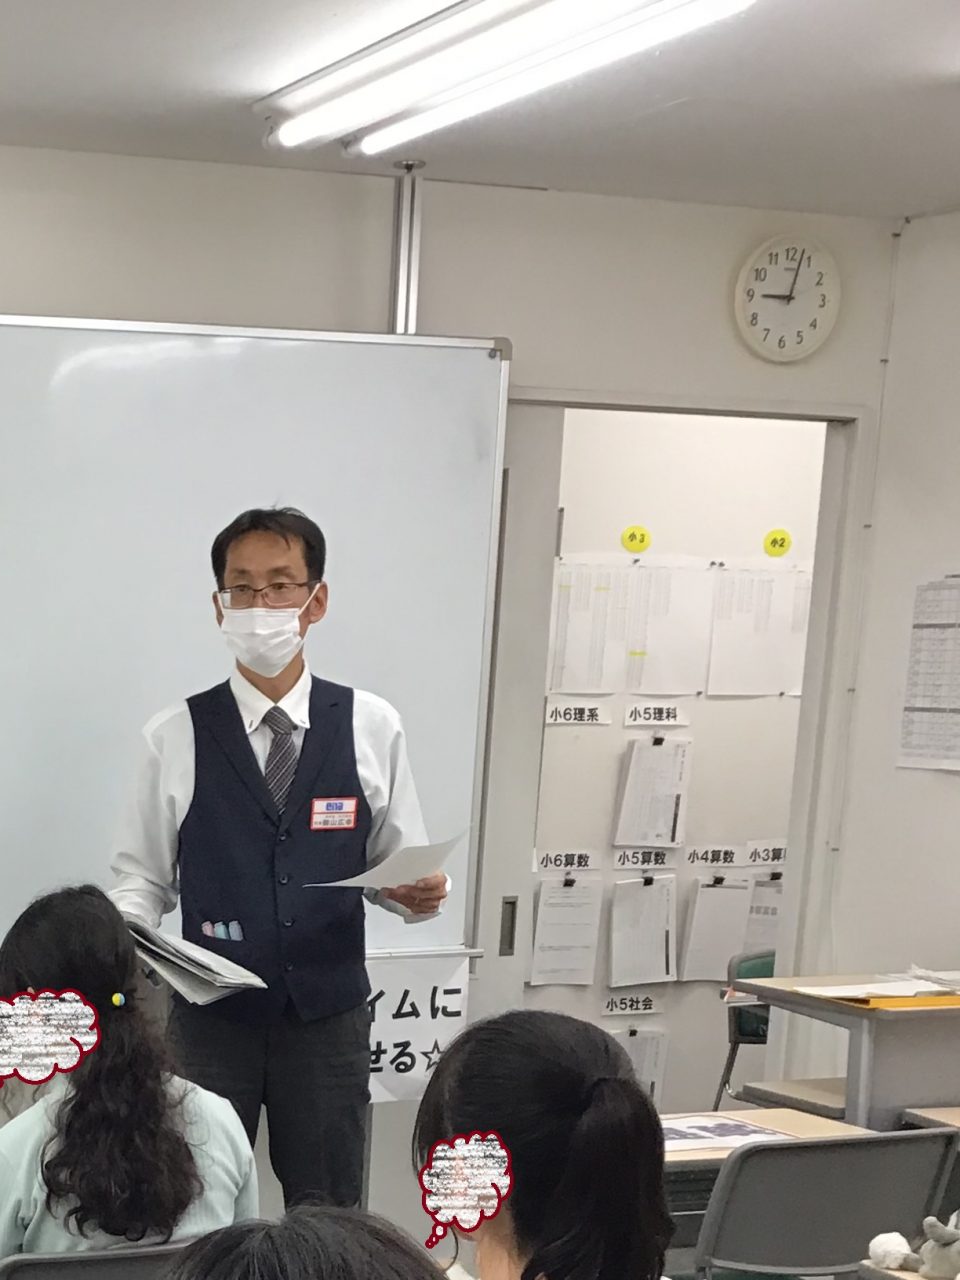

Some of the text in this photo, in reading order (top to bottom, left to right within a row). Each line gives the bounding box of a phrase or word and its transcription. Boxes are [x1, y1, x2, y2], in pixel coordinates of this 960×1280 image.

[768, 252, 779, 265] 11
[785, 247, 798, 262] 12
[754, 268, 768, 282] 10
[815, 272, 824, 286] 2
[746, 288, 755, 303] 9
[818, 294, 826, 308] 3
[750, 312, 758, 326] 8
[809, 318, 817, 330] 4
[762, 328, 770, 342] 7
[778, 335, 786, 349] 6
[796, 331, 804, 344] 5
[550, 707, 599, 722] 小6理系
[629, 707, 678, 721] 小5理科
[540, 853, 590, 868] 小6算数
[617, 851, 667, 866] 小5算数
[688, 849, 735, 864] 小4算数
[749, 848, 787, 863] 小3算
[606, 996, 653, 1012] 小5社会
